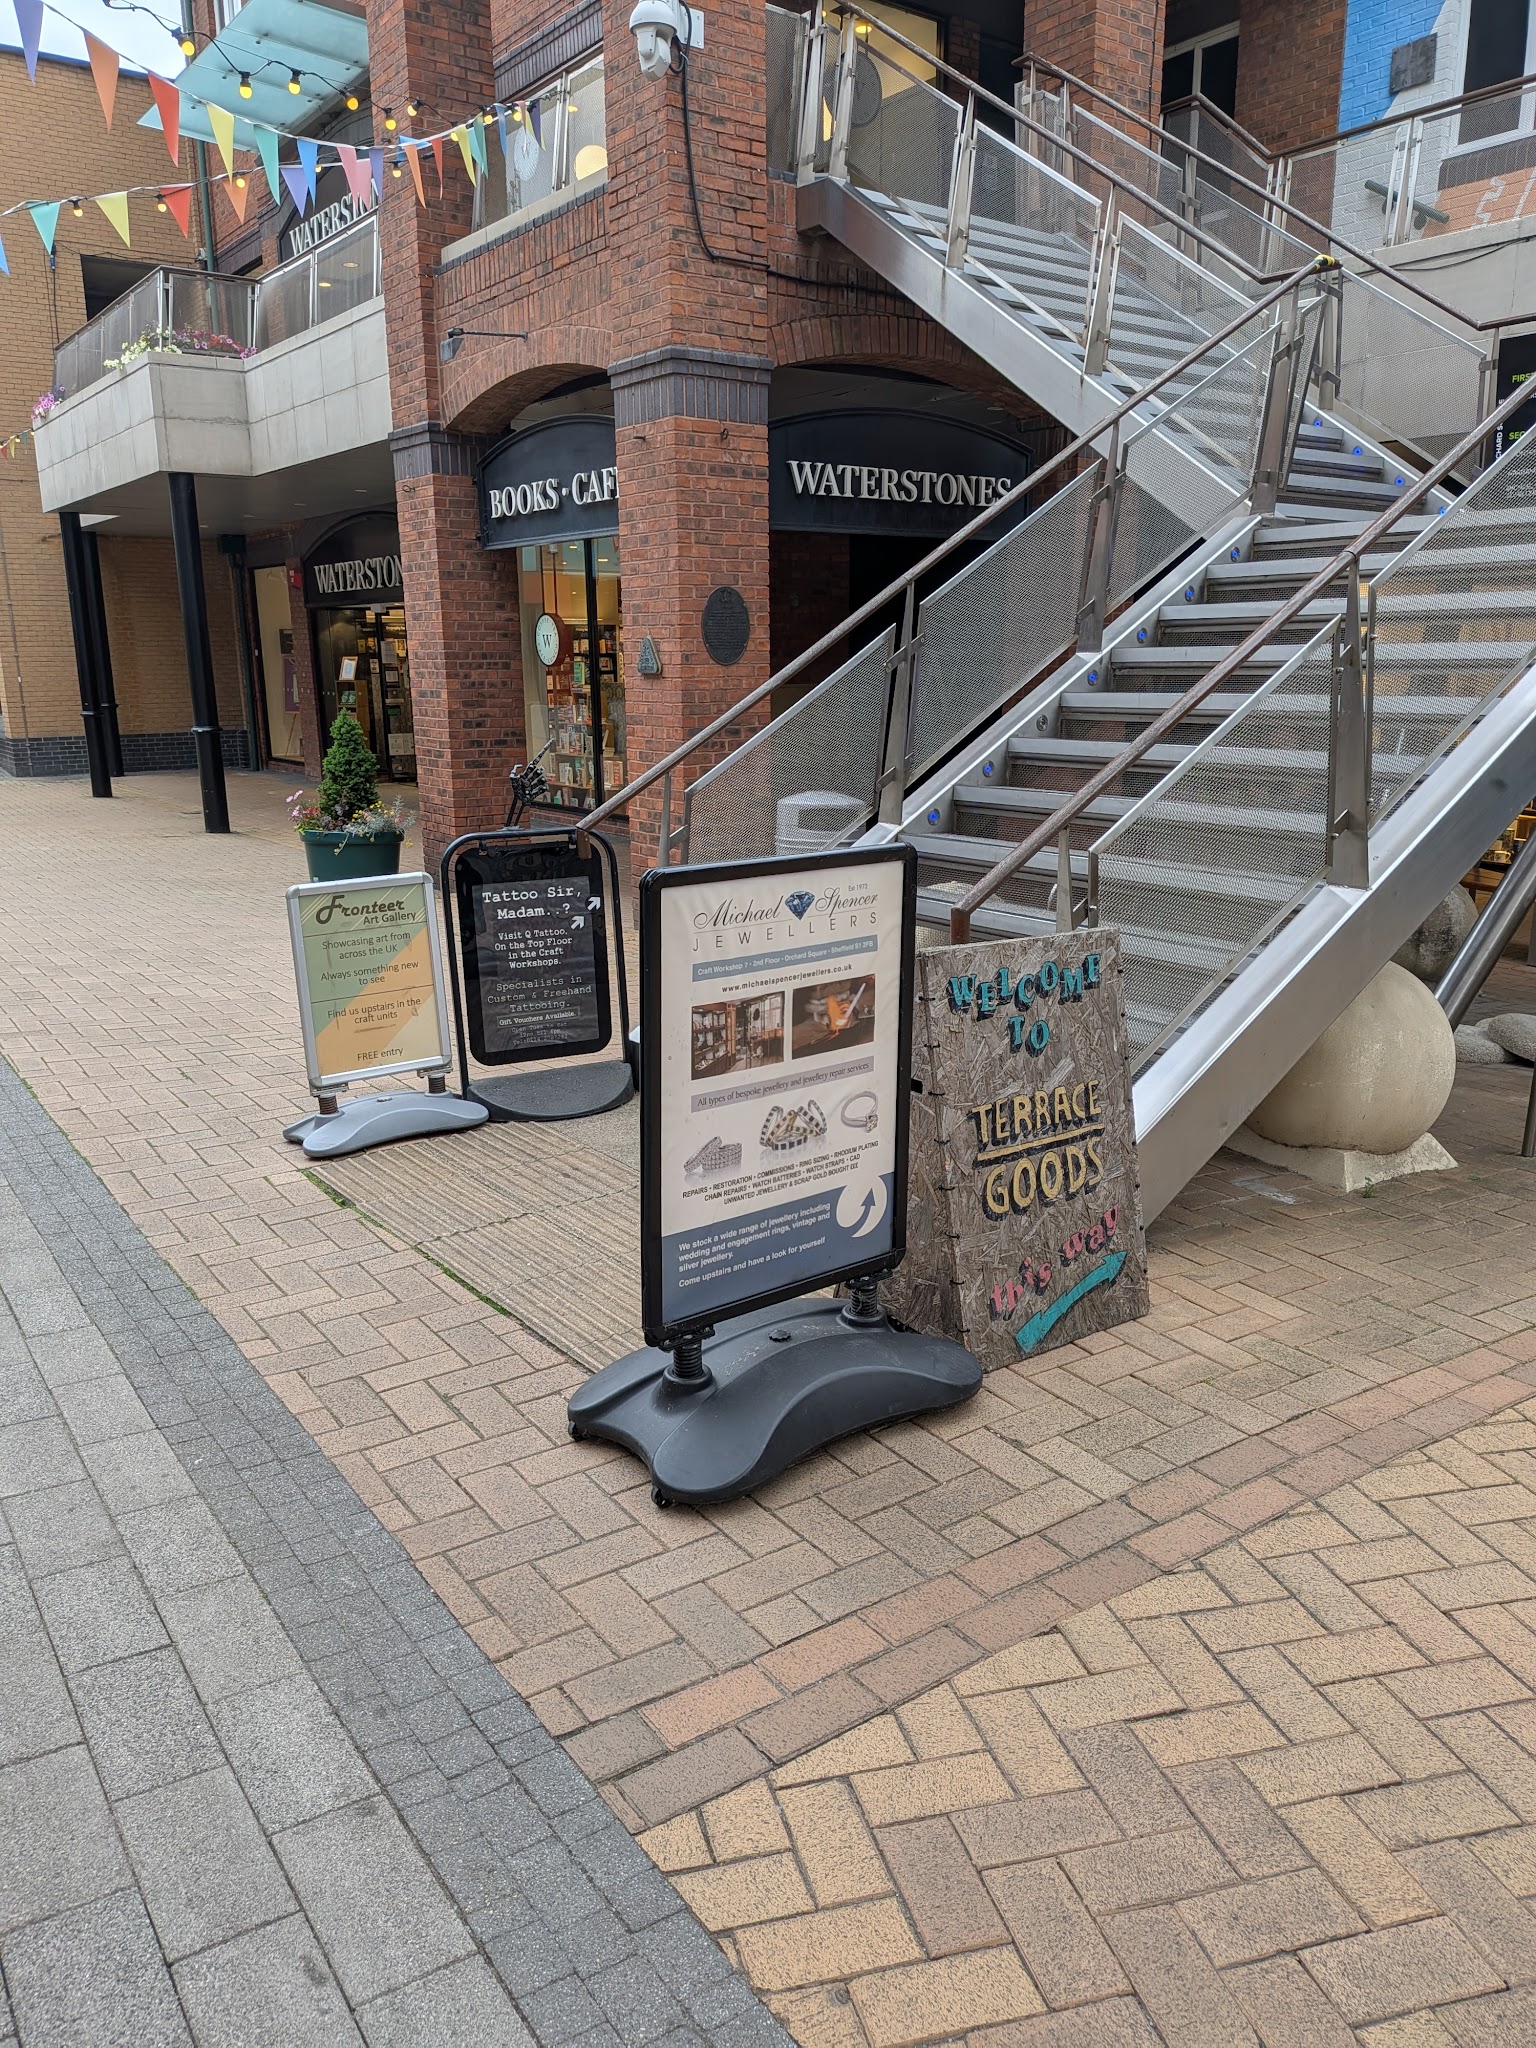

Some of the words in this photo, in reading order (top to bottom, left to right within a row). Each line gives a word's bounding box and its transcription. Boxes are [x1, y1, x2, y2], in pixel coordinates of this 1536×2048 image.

[1511, 372, 1534, 383] FIRS
[786, 460, 1012, 507] WATERSTONES
[489, 478, 559, 519] BOOKS
[542, 634, 552, 648] W
[482, 890, 538, 903] Tattoo
[547, 886, 581, 898] Sir,
[316, 894, 405, 924] Fronteer
[363, 915, 379, 925] Art
[381, 912, 417, 922] Gallery
[693, 895, 784, 929] Michael
[814, 887, 878, 918] Spencer
[322, 937, 374, 950] Showcasing
[376, 934, 388, 943] art
[390, 932, 411, 941] from
[498, 932, 522, 941] Visit
[524, 930, 531, 939] Q
[534, 928, 568, 937] Tattoo.
[692, 911, 877, 951] JEWELLERS
[339, 949, 367, 959] across
[369, 947, 383, 955] the
[385, 944, 398, 953] UK
[494, 943, 506, 951] On
[509, 941, 525, 949] the
[527, 940, 545, 949] Top
[547, 937, 573, 946] Floor
[508, 951, 518, 960] in
[520, 950, 536, 958] the
[539, 947, 564, 956] Craft
[509, 958, 561, 969] Workshops.
[697, 967, 713, 976] Craft
[713, 963, 743, 973] Workshop
[753, 959, 764, 967] 2nd
[764, 957, 780, 965] Floor
[784, 952, 806, 961] Orchard
[807, 949, 827, 958] Square
[831, 944, 854, 954] Sheffield
[320, 970, 351, 981] Always
[354, 964, 399, 977] something
[401, 962, 419, 970] new
[370, 975, 385, 984] see
[722, 964, 852, 992] www.michaelspencerjewellers.co.uk
[487, 993, 526, 1004] Custom
[544, 985, 592, 998] Freehand
[496, 978, 564, 992] Specialists
[948, 953, 1102, 1016] WELCOME
[328, 1008, 346, 1019] Find
[349, 1008, 359, 1016] us
[361, 1002, 395, 1016] upstairs
[396, 1000, 404, 1008] in
[407, 998, 421, 1006] the
[510, 1001, 570, 1012] Tattooing.
[354, 1014, 374, 1024] craft
[376, 1011, 398, 1021] units
[514, 1016, 543, 1024] Vouchers
[1008, 1014, 1050, 1055] TO
[357, 1051, 378, 1061] FREE
[380, 1048, 403, 1057] entry
[697, 1098, 707, 1106] All
[708, 1094, 726, 1106] types
[727, 1091, 735, 1100] of
[735, 1087, 762, 1099] bespoke
[762, 1080, 790, 1096] jewellery
[790, 1077, 802, 1087] and
[802, 1072, 829, 1087] jewellery
[830, 1067, 846, 1078] repair
[847, 1062, 870, 1074] services
[969, 1080, 1102, 1146] TERRACE
[682, 1186, 708, 1198] REPAIRS
[712, 1175, 753, 1190] RESTORATION
[757, 1163, 795, 1179] COMMISSIONS
[799, 1159, 812, 1168] RING
[813, 1154, 830, 1164] SIZING
[834, 1147, 858, 1158] RHODIUM
[858, 1140, 879, 1151] PLATING
[704, 1192, 722, 1201] CHAIN
[723, 1185, 747, 1196] REPAIRS
[752, 1179, 772, 1189] WATCH
[772, 1170, 801, 1183] BATTERIES
[806, 1164, 824, 1174] WATCH
[825, 1158, 845, 1168] STRAPS
[983, 1136, 1105, 1219] GOODS
[724, 1192, 755, 1205] UNWANTED
[756, 1180, 789, 1196] JEWELLERY
[794, 1176, 812, 1186] SCRAP
[812, 1172, 827, 1181] GOLD
[828, 1165, 849, 1176] BOUGHT
[678, 1243, 690, 1252] We
[692, 1236, 713, 1248] stock
[720, 1230, 737, 1240] wide
[738, 1224, 759, 1234] range
[760, 1220, 767, 1228] of
[768, 1212, 799, 1228] jewellery
[800, 1203, 830, 1217] including
[678, 1248, 710, 1262] wedding
[712, 1243, 726, 1252] and
[727, 1230, 770, 1248] engagement
[771, 1224, 791, 1234] rings,
[792, 1217, 816, 1228] vintage
[818, 1212, 830, 1221] and
[678, 1261, 699, 1272] silver
[700, 1251, 734, 1268] jewellery.
[678, 1275, 701, 1288] Come
[702, 1266, 732, 1281] upstairs
[733, 1261, 747, 1271] and
[748, 1256, 765, 1267] have
[772, 1249, 786, 1259] look
[799, 1236, 826, 1252] yourself
